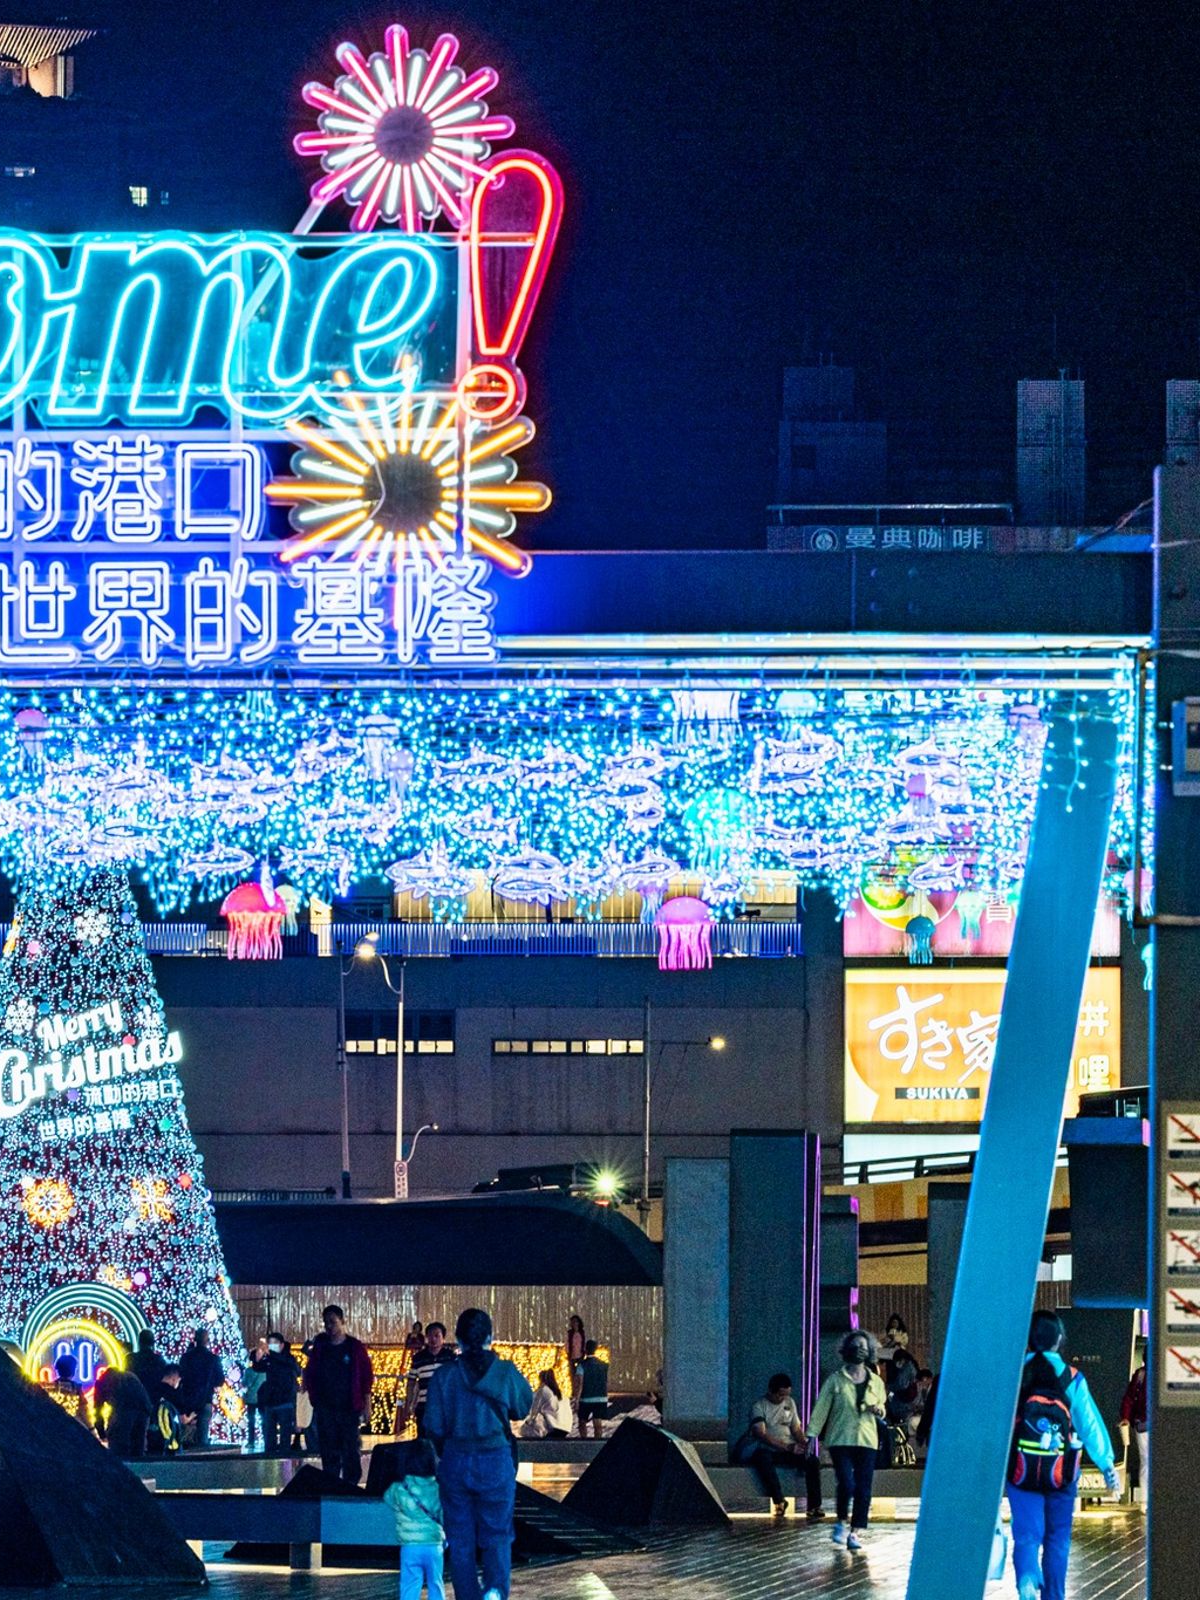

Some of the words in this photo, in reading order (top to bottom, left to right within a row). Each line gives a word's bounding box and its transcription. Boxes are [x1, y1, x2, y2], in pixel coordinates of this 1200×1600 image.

[845, 526, 984, 550] 曼典咖啡
[35, 999, 124, 1053] Merry
[83, 1078, 179, 1107] 流動的港口
[905, 1087, 969, 1100] SUKIYA
[38, 1108, 132, 1142] 世界的基隆
